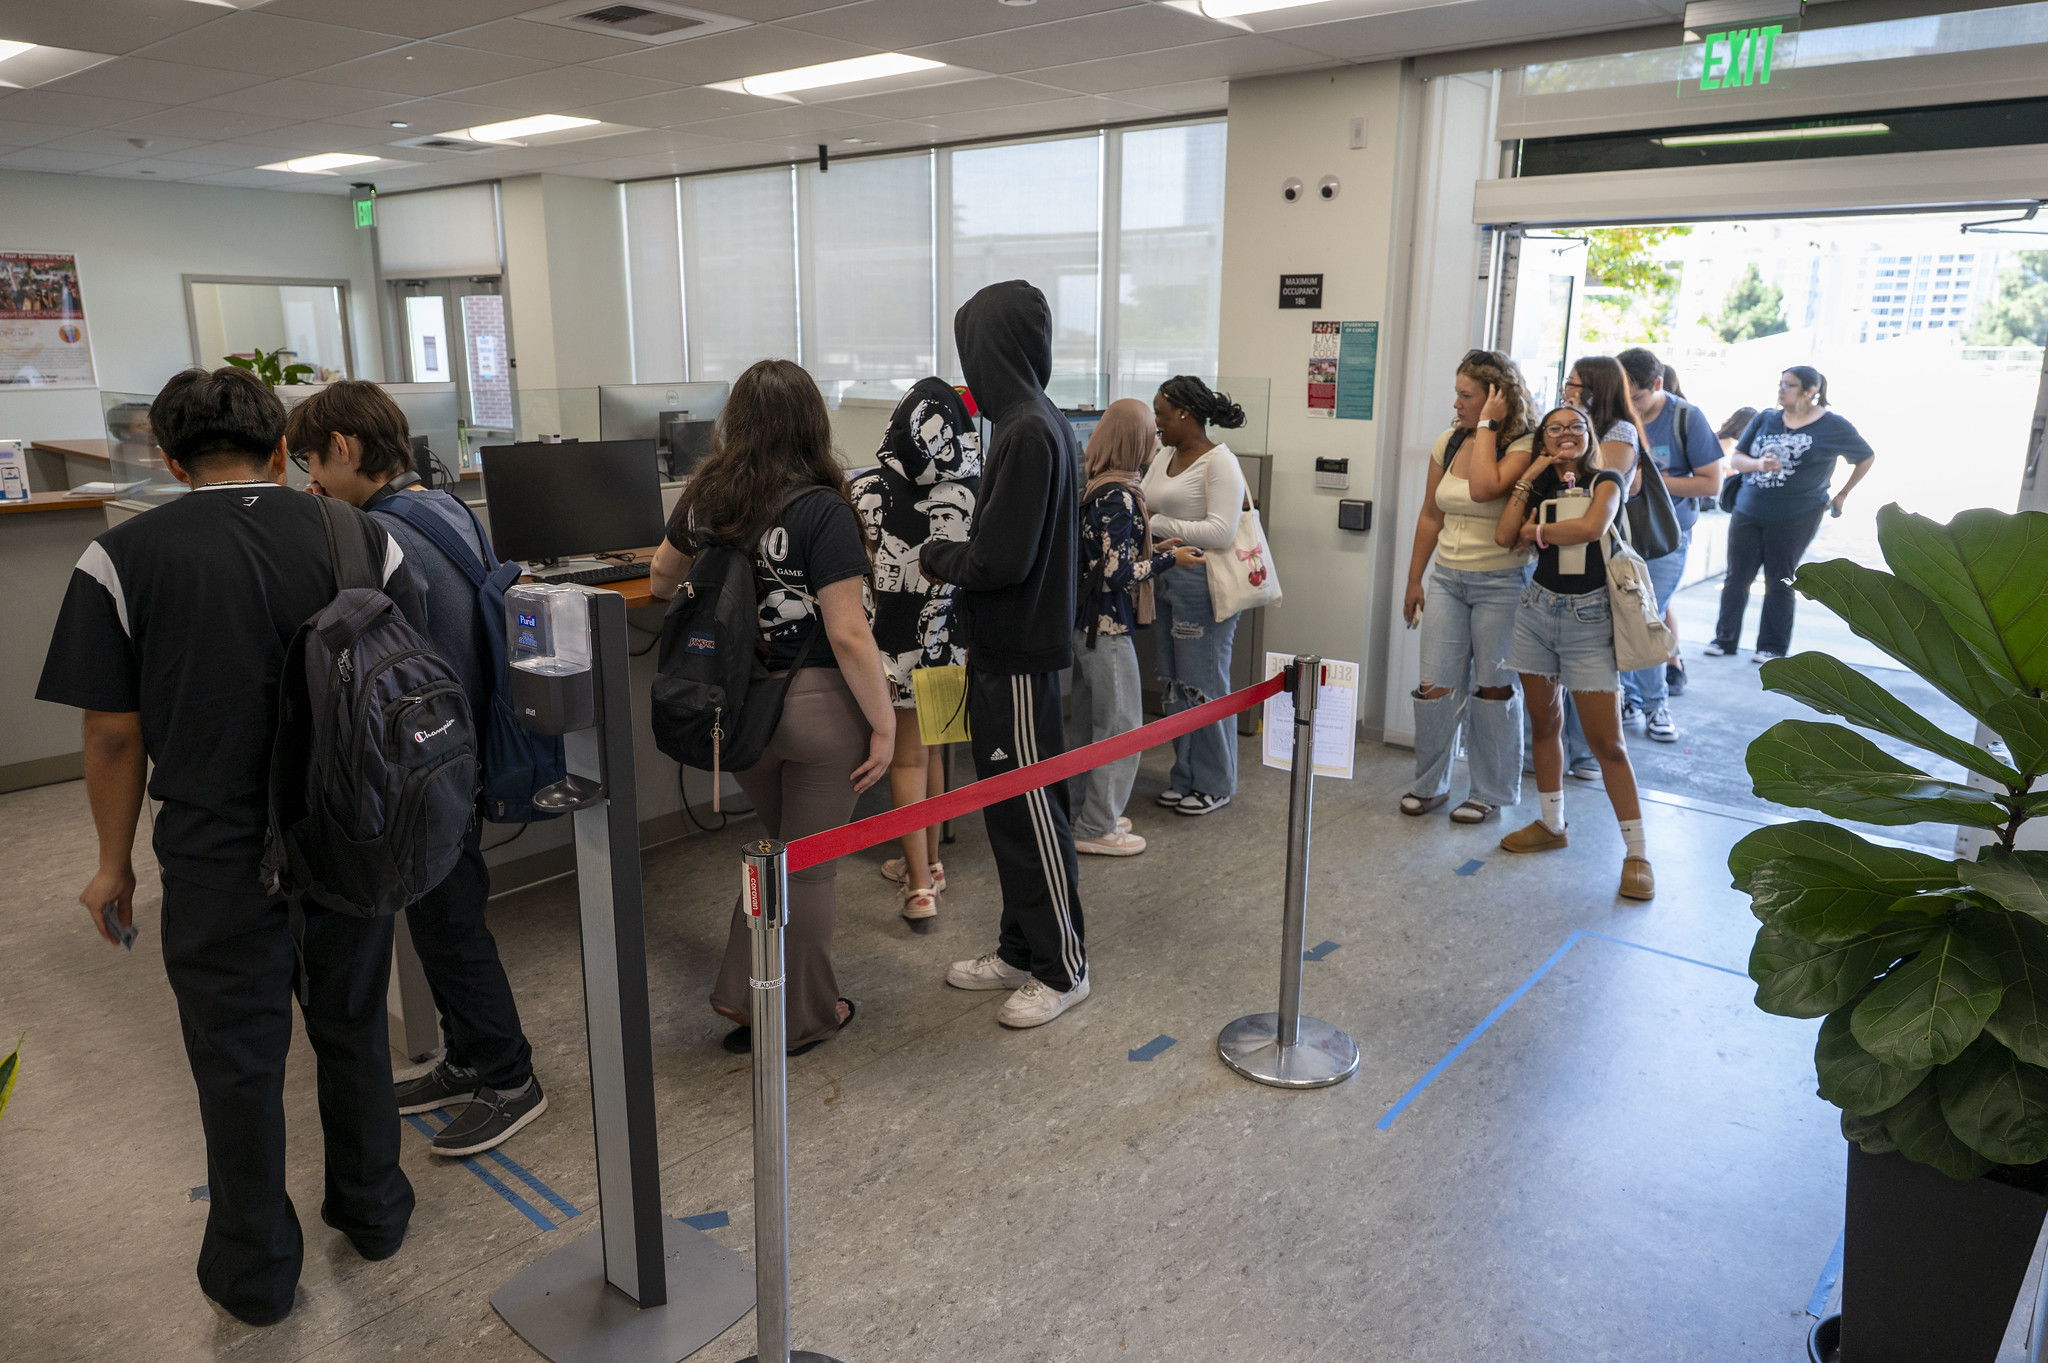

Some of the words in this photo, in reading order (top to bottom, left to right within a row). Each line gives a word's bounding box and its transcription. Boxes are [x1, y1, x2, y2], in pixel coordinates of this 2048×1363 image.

[1700, 24, 1783, 91] EXIT
[357, 200, 373, 226] EXIT
[1285, 277, 1318, 285] MAXIMUM
[1282, 287, 1320, 296] OCCUPANCY
[1314, 334, 1338, 344] LIVE
[1312, 349, 1337, 358] CODE
[776, 567, 804, 577] GAME
[877, 576, 886, 589] 8
[888, 578, 897, 591] 2
[414, 718, 455, 743] Champion
[750, 877, 759, 911] corovan
